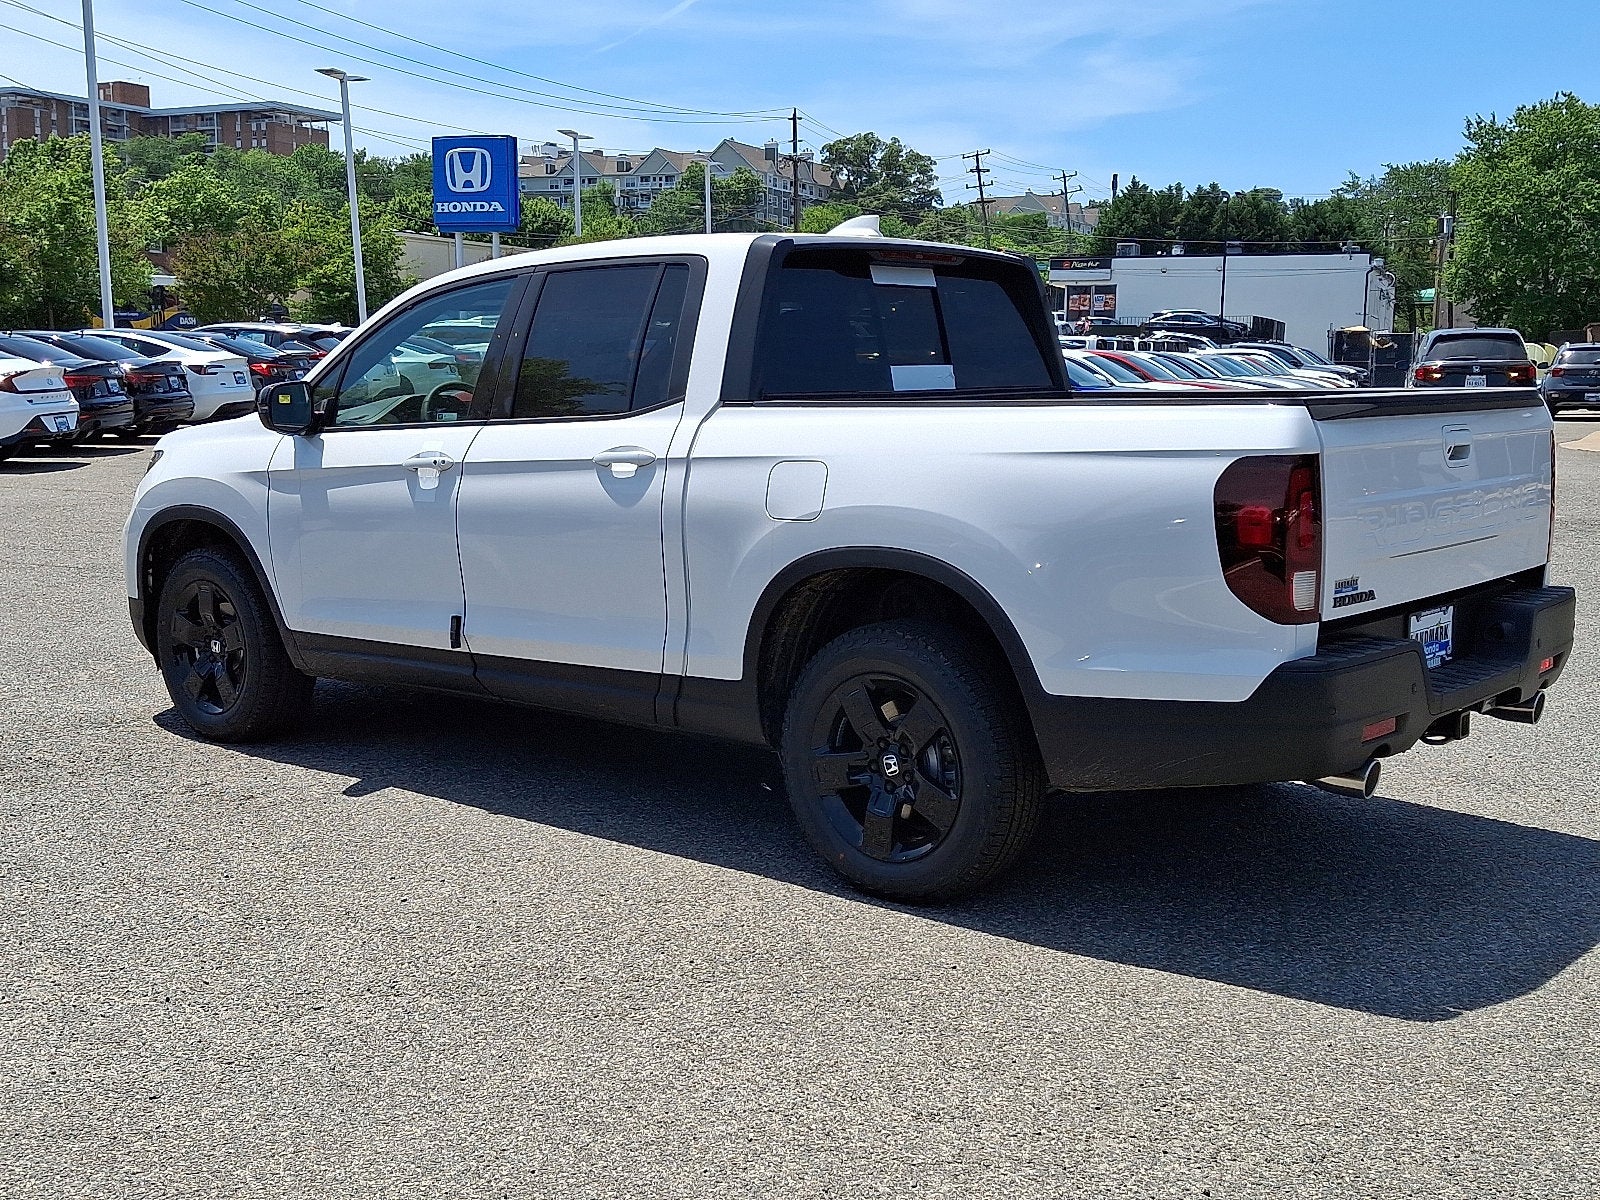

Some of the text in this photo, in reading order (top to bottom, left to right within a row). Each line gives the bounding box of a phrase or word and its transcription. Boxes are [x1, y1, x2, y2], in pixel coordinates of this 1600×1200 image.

[436, 201, 505, 212] HONDA
[180, 317, 196, 325] DASH
[1332, 589, 1377, 608] HONDA
[1410, 622, 1451, 645] ANDMARK
[1424, 642, 1440, 655] onda
